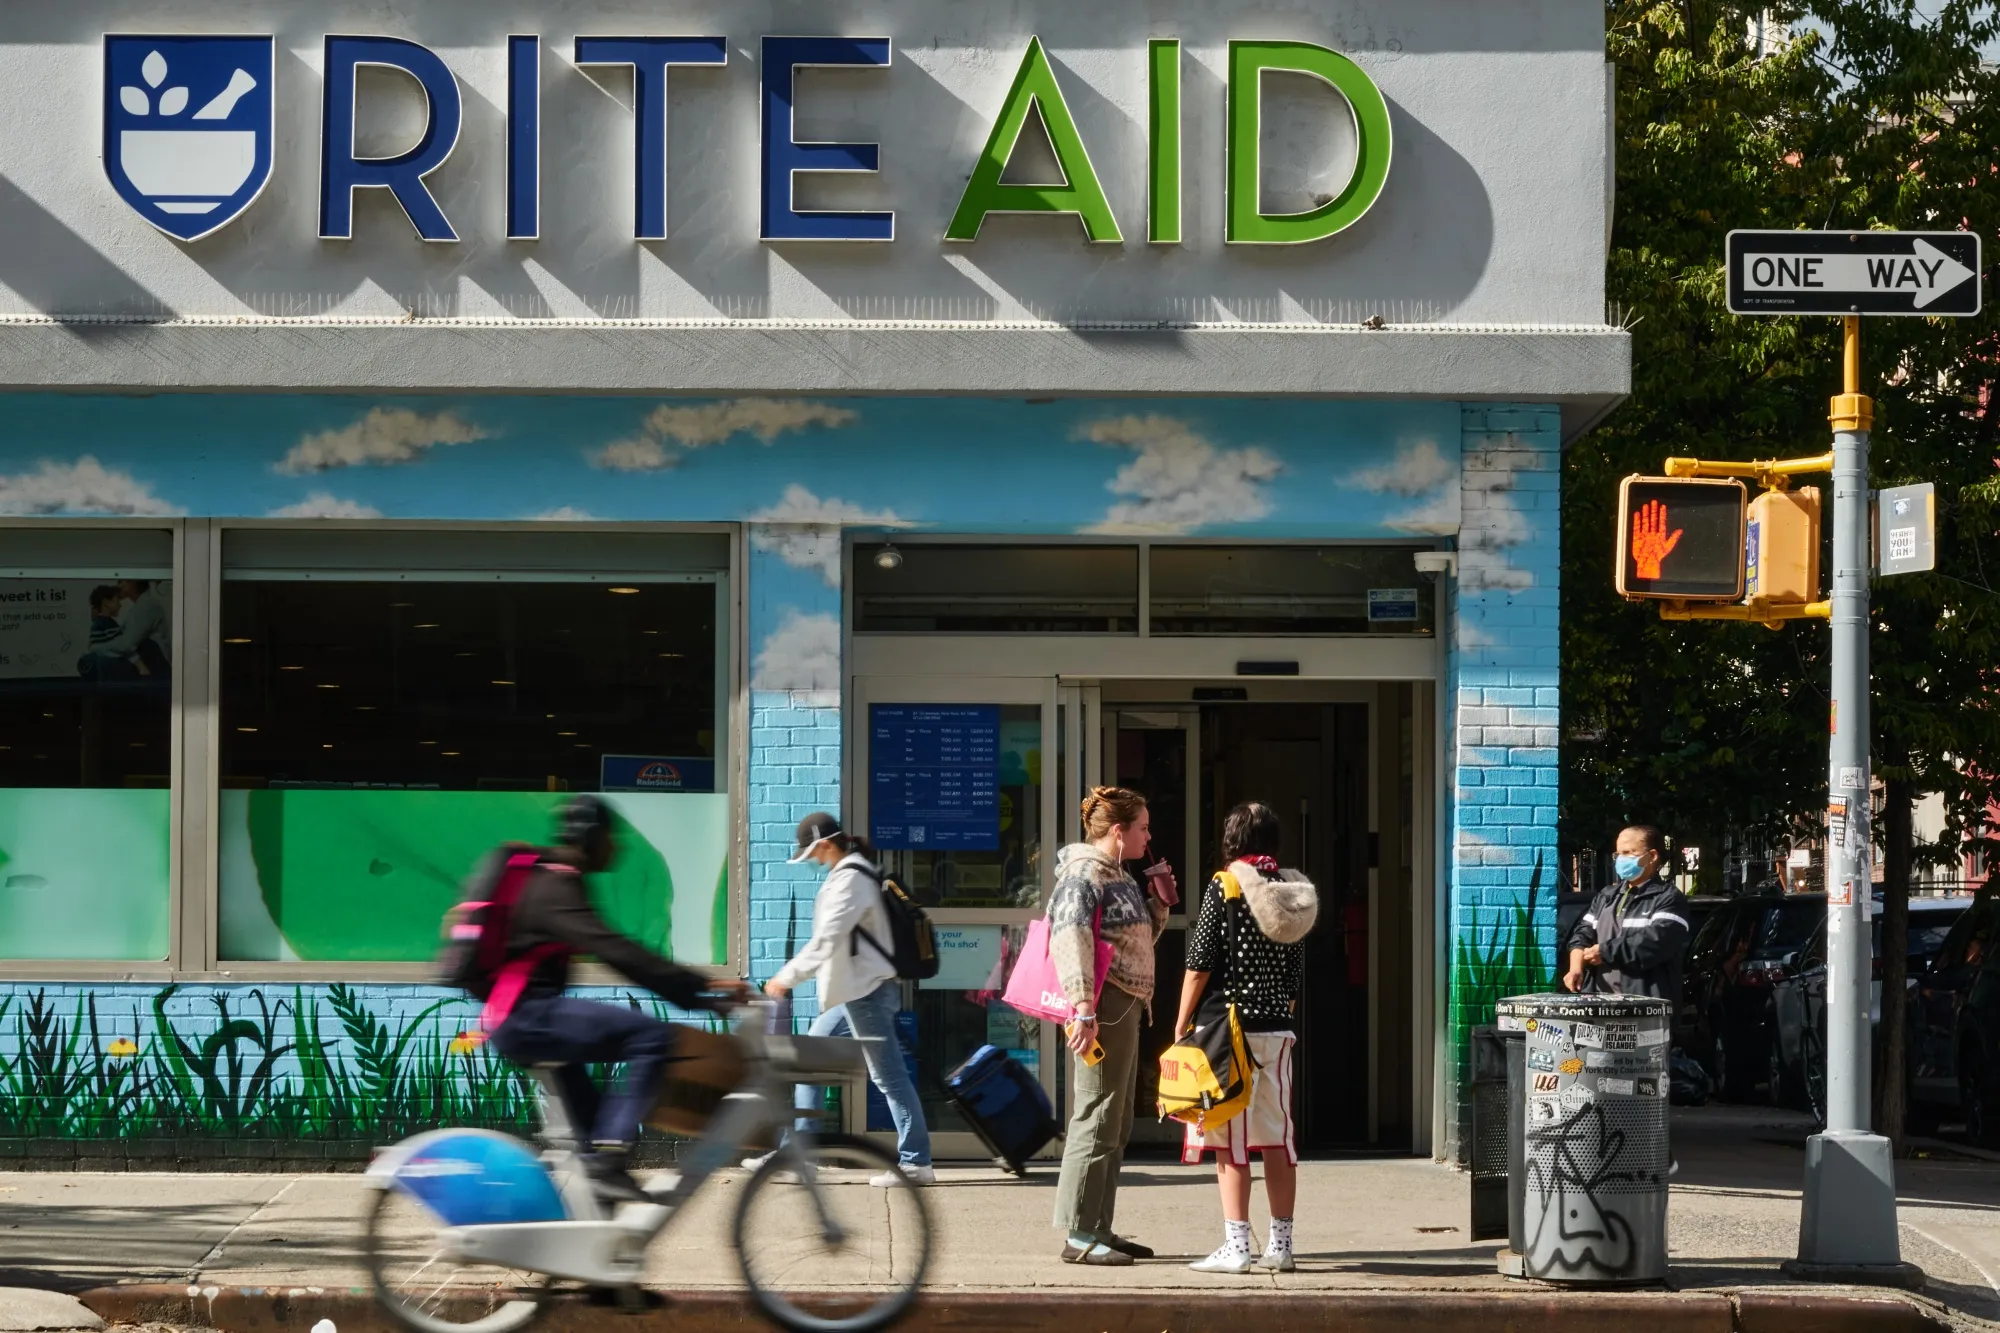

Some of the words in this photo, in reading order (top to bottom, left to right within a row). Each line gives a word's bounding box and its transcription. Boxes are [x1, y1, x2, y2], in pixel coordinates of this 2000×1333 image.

[318, 33, 896, 243] RITE
[942, 35, 1393, 245] AID
[1752, 257, 1824, 287] ONE
[1867, 258, 1945, 288] WAY
[1890, 531, 1909, 539] YEAH
[1890, 537, 1909, 548] YOU
[1890, 547, 1909, 557] CAN
[36, 589, 47, 602] it
[50, 588, 66, 602] is!
[3, 612, 21, 621] that
[23, 611, 41, 621] add
[43, 614, 55, 622] up
[57, 612, 67, 620] to
[637, 778, 681, 786] RainShield
[941, 932, 963, 940] your
[944, 940, 956, 948] flu
[1497, 1003, 1512, 1013] Don't
[1514, 1004, 1538, 1014] litter
[1559, 1006, 1593, 1016] Don't
[1598, 1007, 1627, 1016] litter
[1606, 1024, 1637, 1032] OPTIMIST
[1606, 1033, 1637, 1042] ATLANTIC
[1605, 1042, 1636, 1050] ISLANDER
[1625, 1057, 1634, 1065] by
[1584, 1066, 1602, 1074] York
[1604, 1066, 1618, 1075] City
[1620, 1066, 1645, 1074] Council
